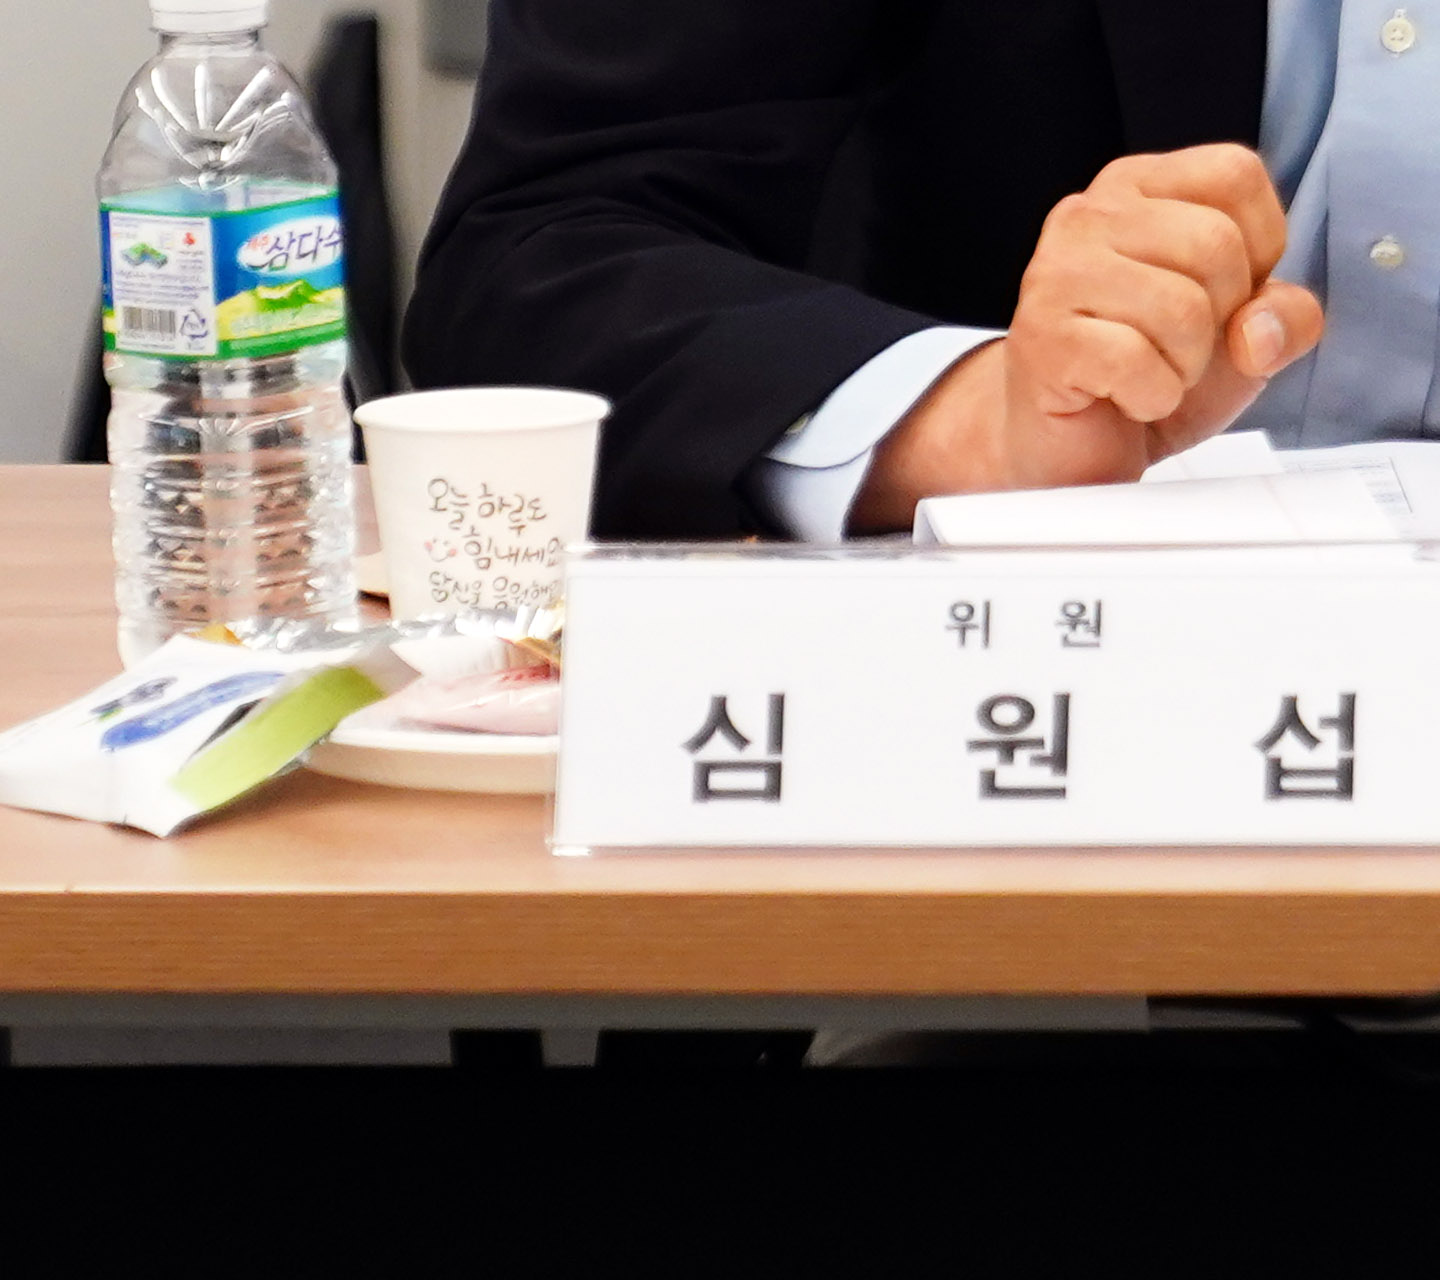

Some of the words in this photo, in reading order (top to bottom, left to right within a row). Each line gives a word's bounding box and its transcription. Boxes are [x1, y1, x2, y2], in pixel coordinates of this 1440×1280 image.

[427, 477, 470, 531] 오늘
[477, 481, 548, 538] 하루도
[462, 524, 562, 570] 힘내세요
[948, 599, 992, 650] 위
[1057, 598, 1104, 649] 원
[682, 691, 787, 805] 심
[965, 690, 1073, 802] 원
[1254, 691, 1358, 803] 섭
